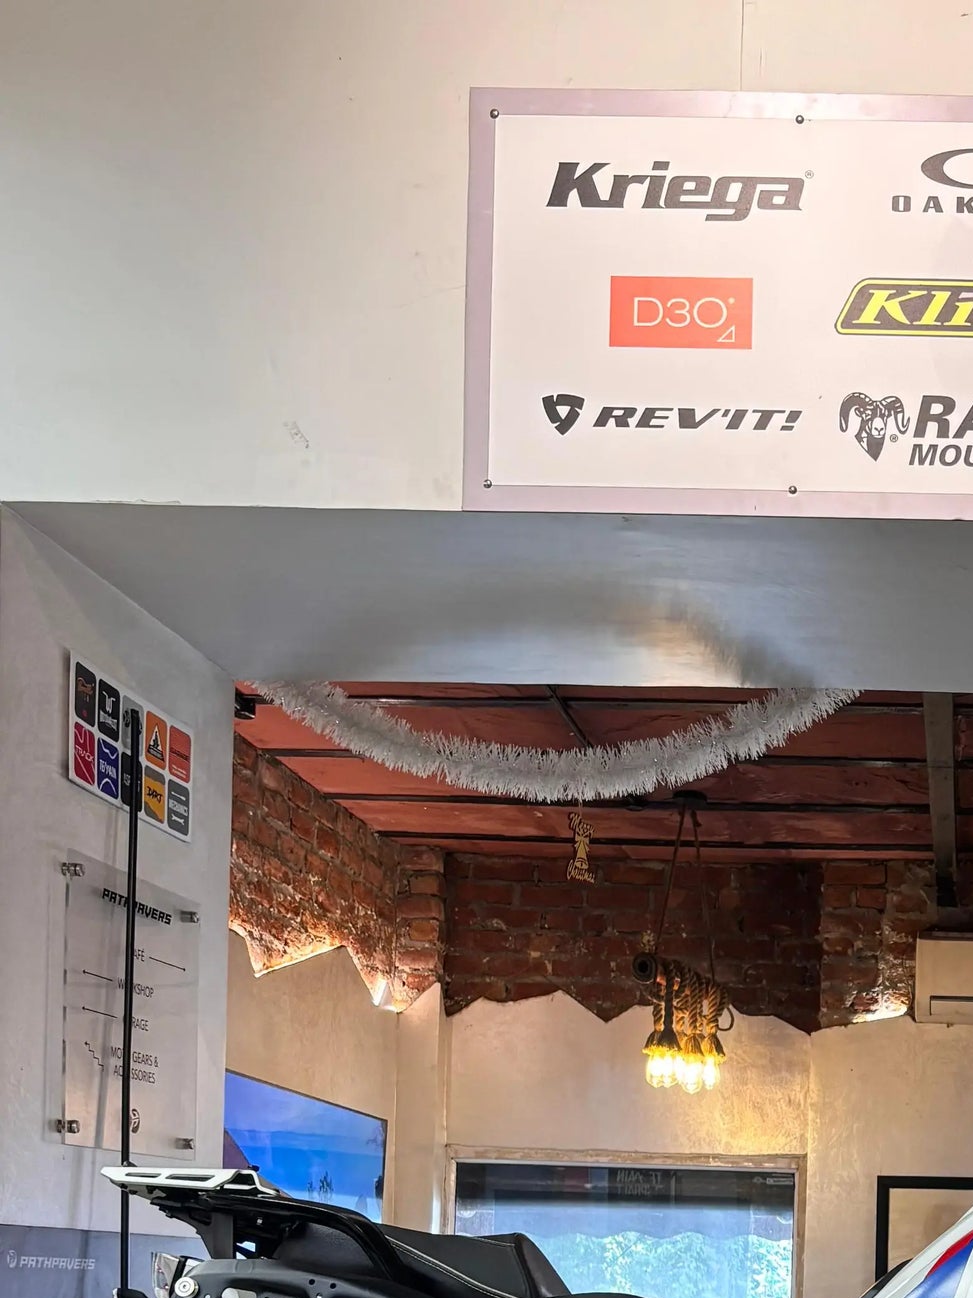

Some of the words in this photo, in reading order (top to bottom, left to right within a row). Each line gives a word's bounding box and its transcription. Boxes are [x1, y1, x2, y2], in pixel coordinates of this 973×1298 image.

[546, 161, 803, 222] Kriega
[592, 406, 803, 433] REV'IT!
[19, 1255, 96, 1270] PATHPAVERS
